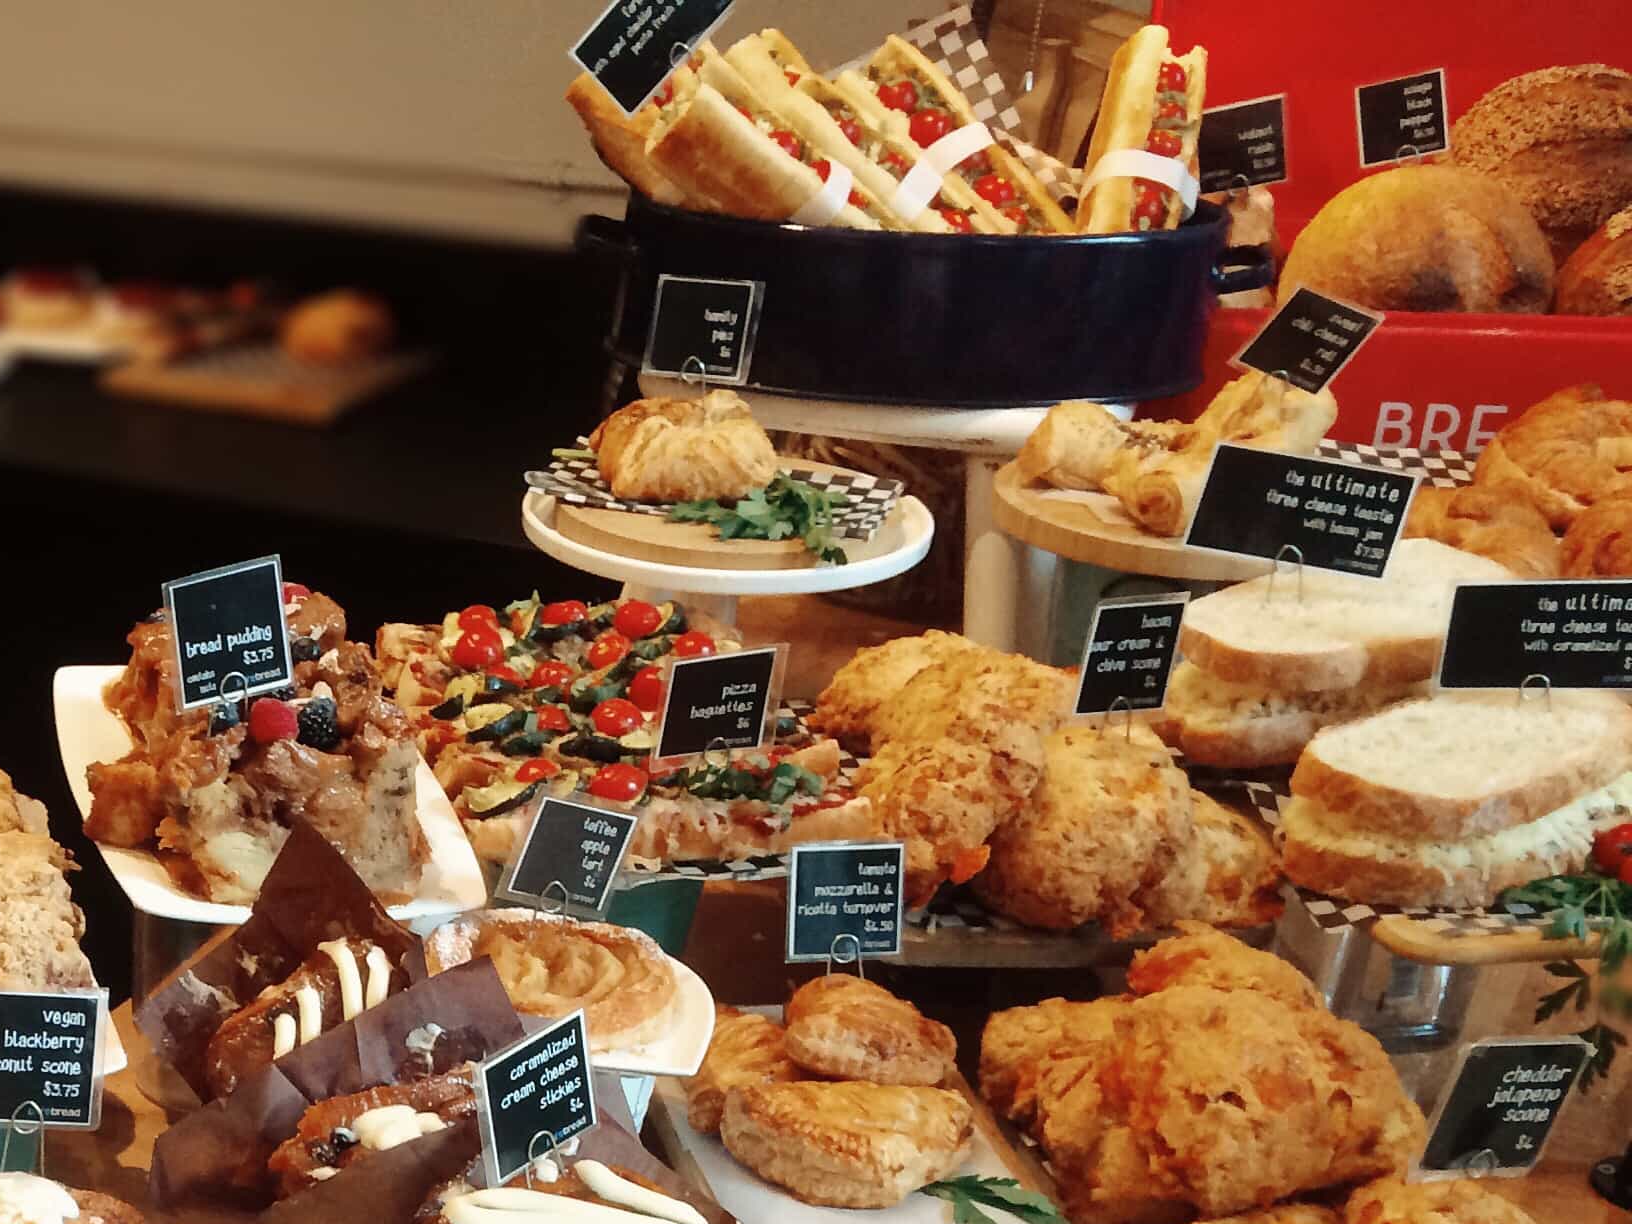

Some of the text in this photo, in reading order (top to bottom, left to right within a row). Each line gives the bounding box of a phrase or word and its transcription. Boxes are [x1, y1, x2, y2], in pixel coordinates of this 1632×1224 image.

[1285, 469, 1400, 503] the ultimate
[1266, 488, 1395, 525] three cheese toastie
[1303, 517, 1326, 534] with
[1537, 597, 1558, 612] the
[1520, 618, 1556, 634] three
[1562, 618, 1608, 635] cheese
[184, 624, 273, 659] bread pudding
[1523, 638, 1549, 653] with
[242, 646, 274, 665] $3.75
[721, 683, 757, 701] pizza
[583, 816, 618, 838] toffee
[580, 839, 611, 856] apple
[581, 855, 604, 872] tart
[857, 861, 897, 876] tomato
[814, 881, 880, 897] mozzarella
[797, 900, 895, 916] ricotta turnover
[42, 1009, 86, 1028] vegan
[3, 1029, 85, 1054] blackberry
[509, 1027, 577, 1082] caramelized
[40, 1060, 82, 1076] scone
[1502, 1064, 1572, 1083] cheddar
[42, 1080, 81, 1098] $3.75
[500, 1055, 579, 1110] cream cheese
[539, 1075, 582, 1110] stickies
[1486, 1085, 1562, 1109] jalapeno
[1502, 1107, 1551, 1123] scone
